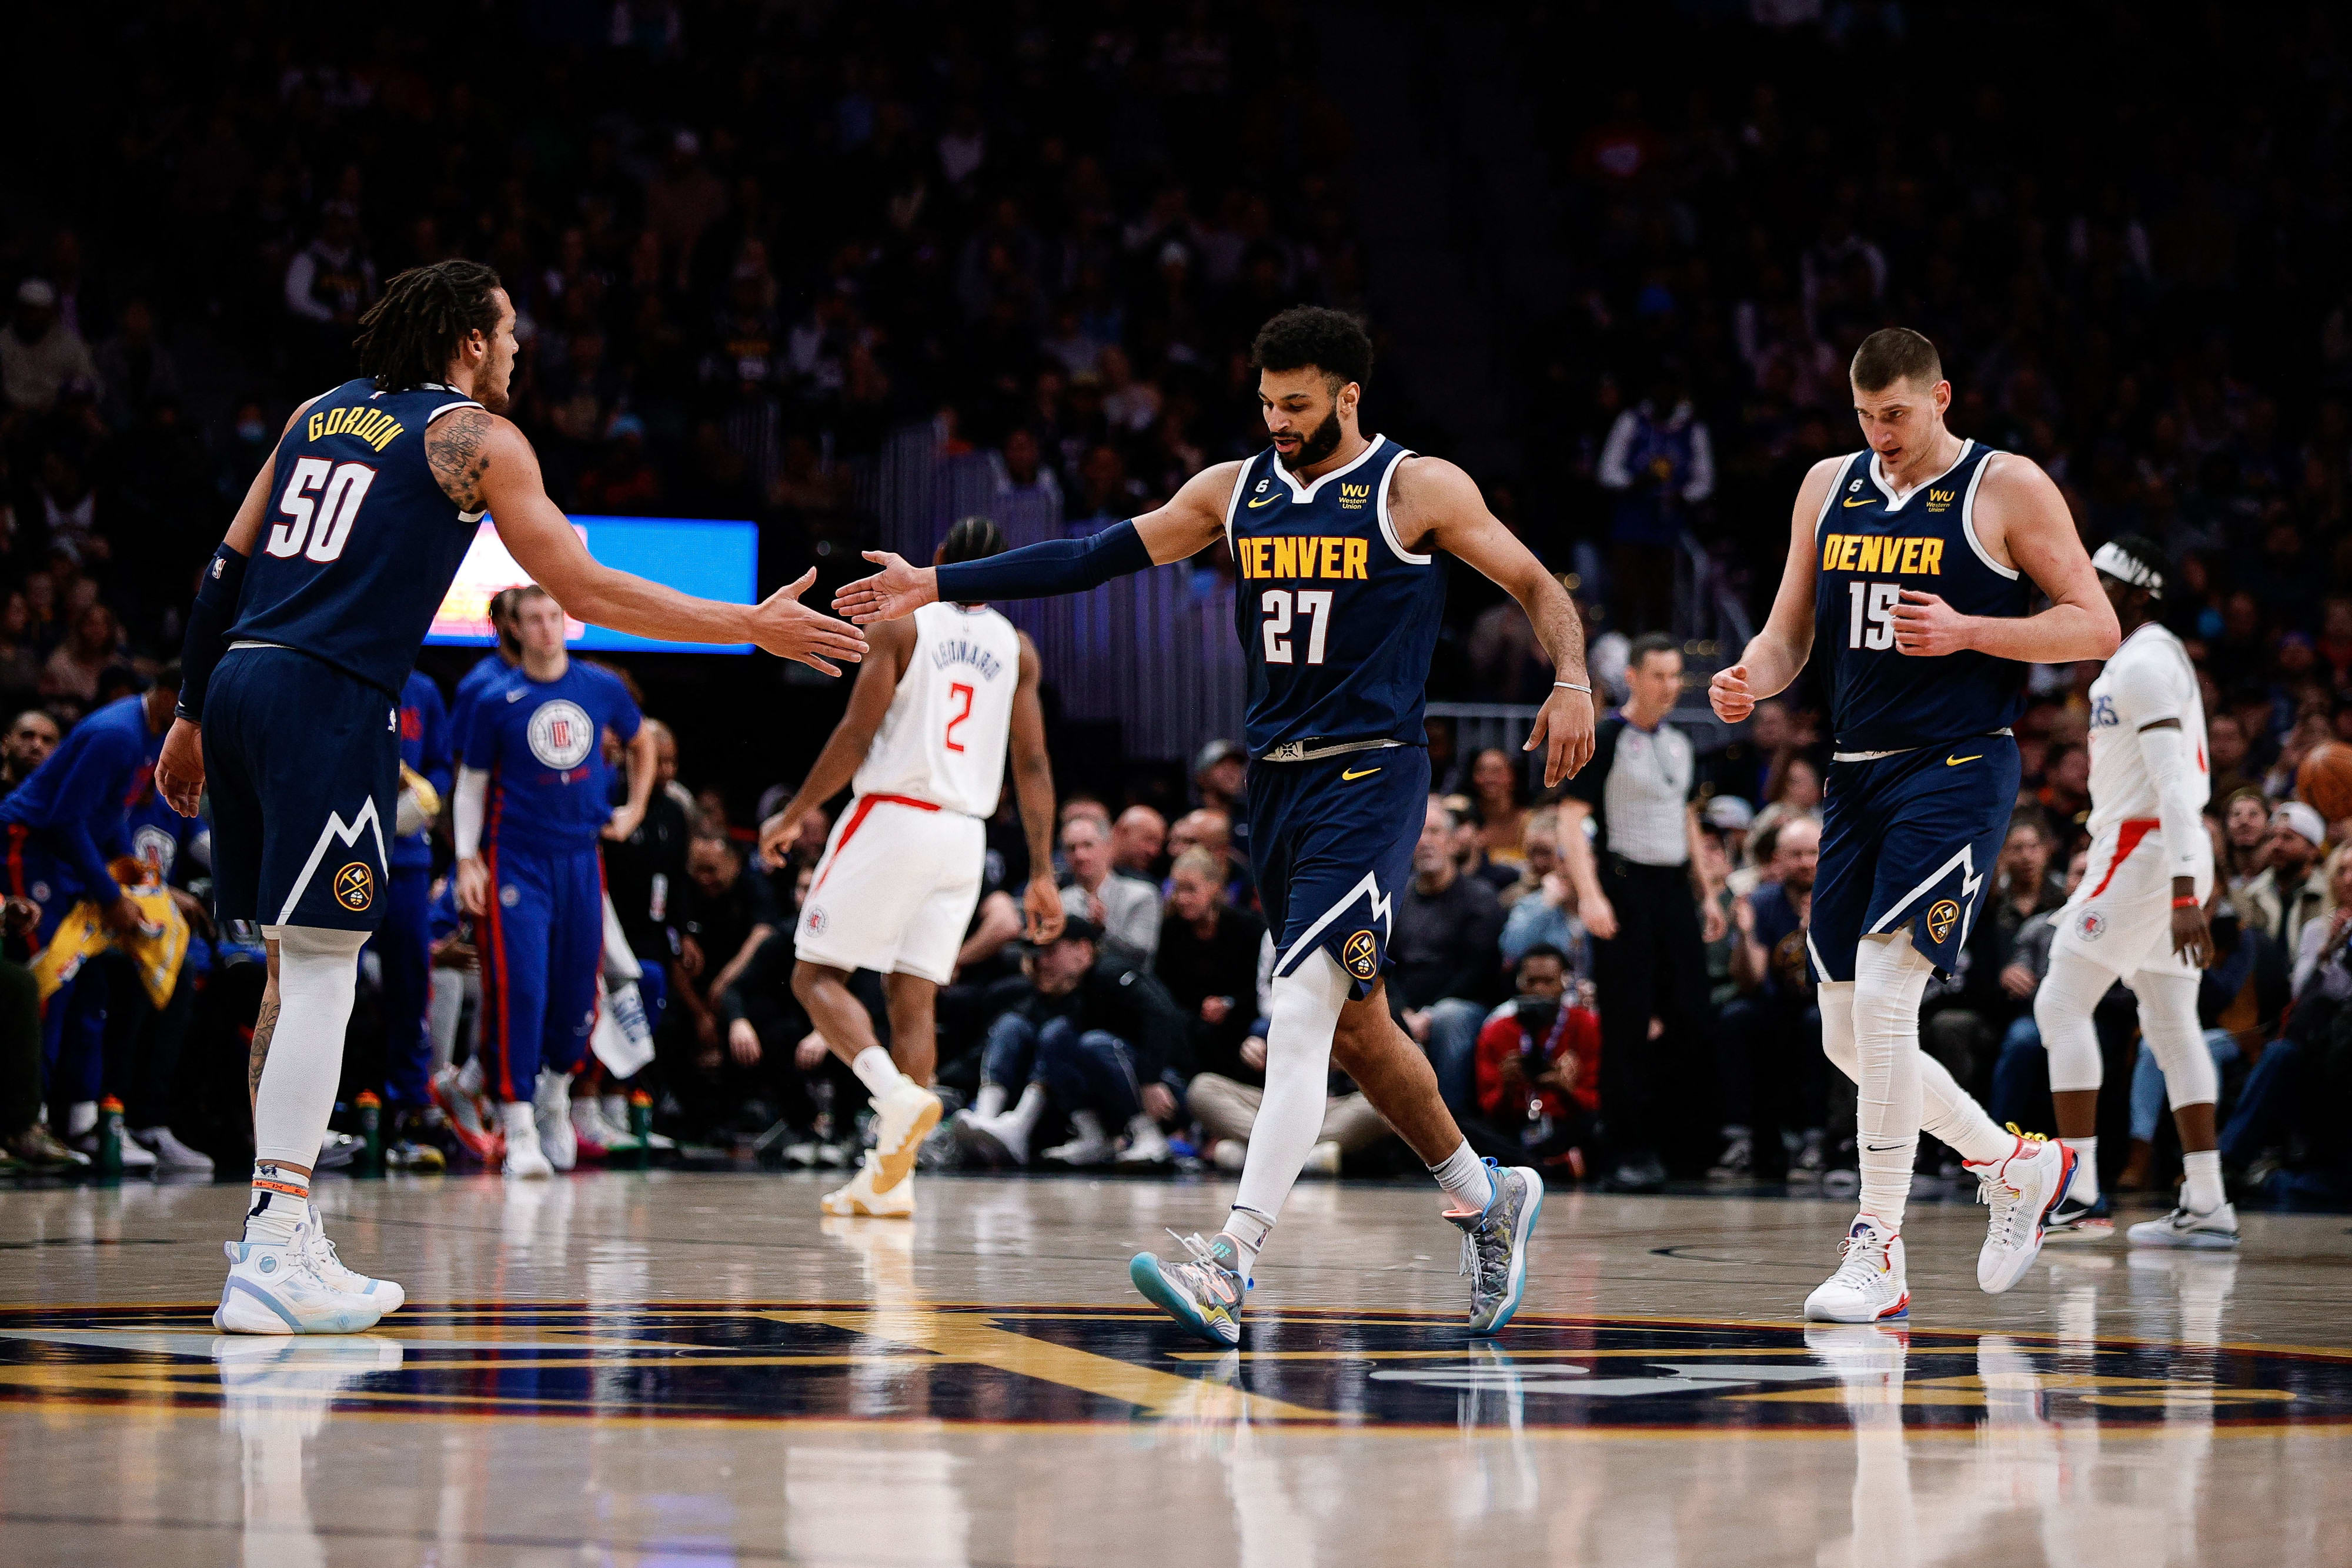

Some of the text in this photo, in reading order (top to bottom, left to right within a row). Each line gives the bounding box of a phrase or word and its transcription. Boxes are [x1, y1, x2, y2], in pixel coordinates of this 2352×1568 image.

[308, 406, 405, 452] GORDON
[1255, 479, 1269, 493] 6
[1341, 483, 1370, 497] WU
[1848, 479, 1863, 493] 6
[1930, 489, 1956, 502] WU
[263, 455, 378, 563] 50
[1237, 536, 1369, 580] DENVER
[1822, 533, 1945, 576] DENVER
[1261, 588, 1335, 666] 27
[1849, 580, 1903, 651] 15
[946, 681, 974, 752] 2
